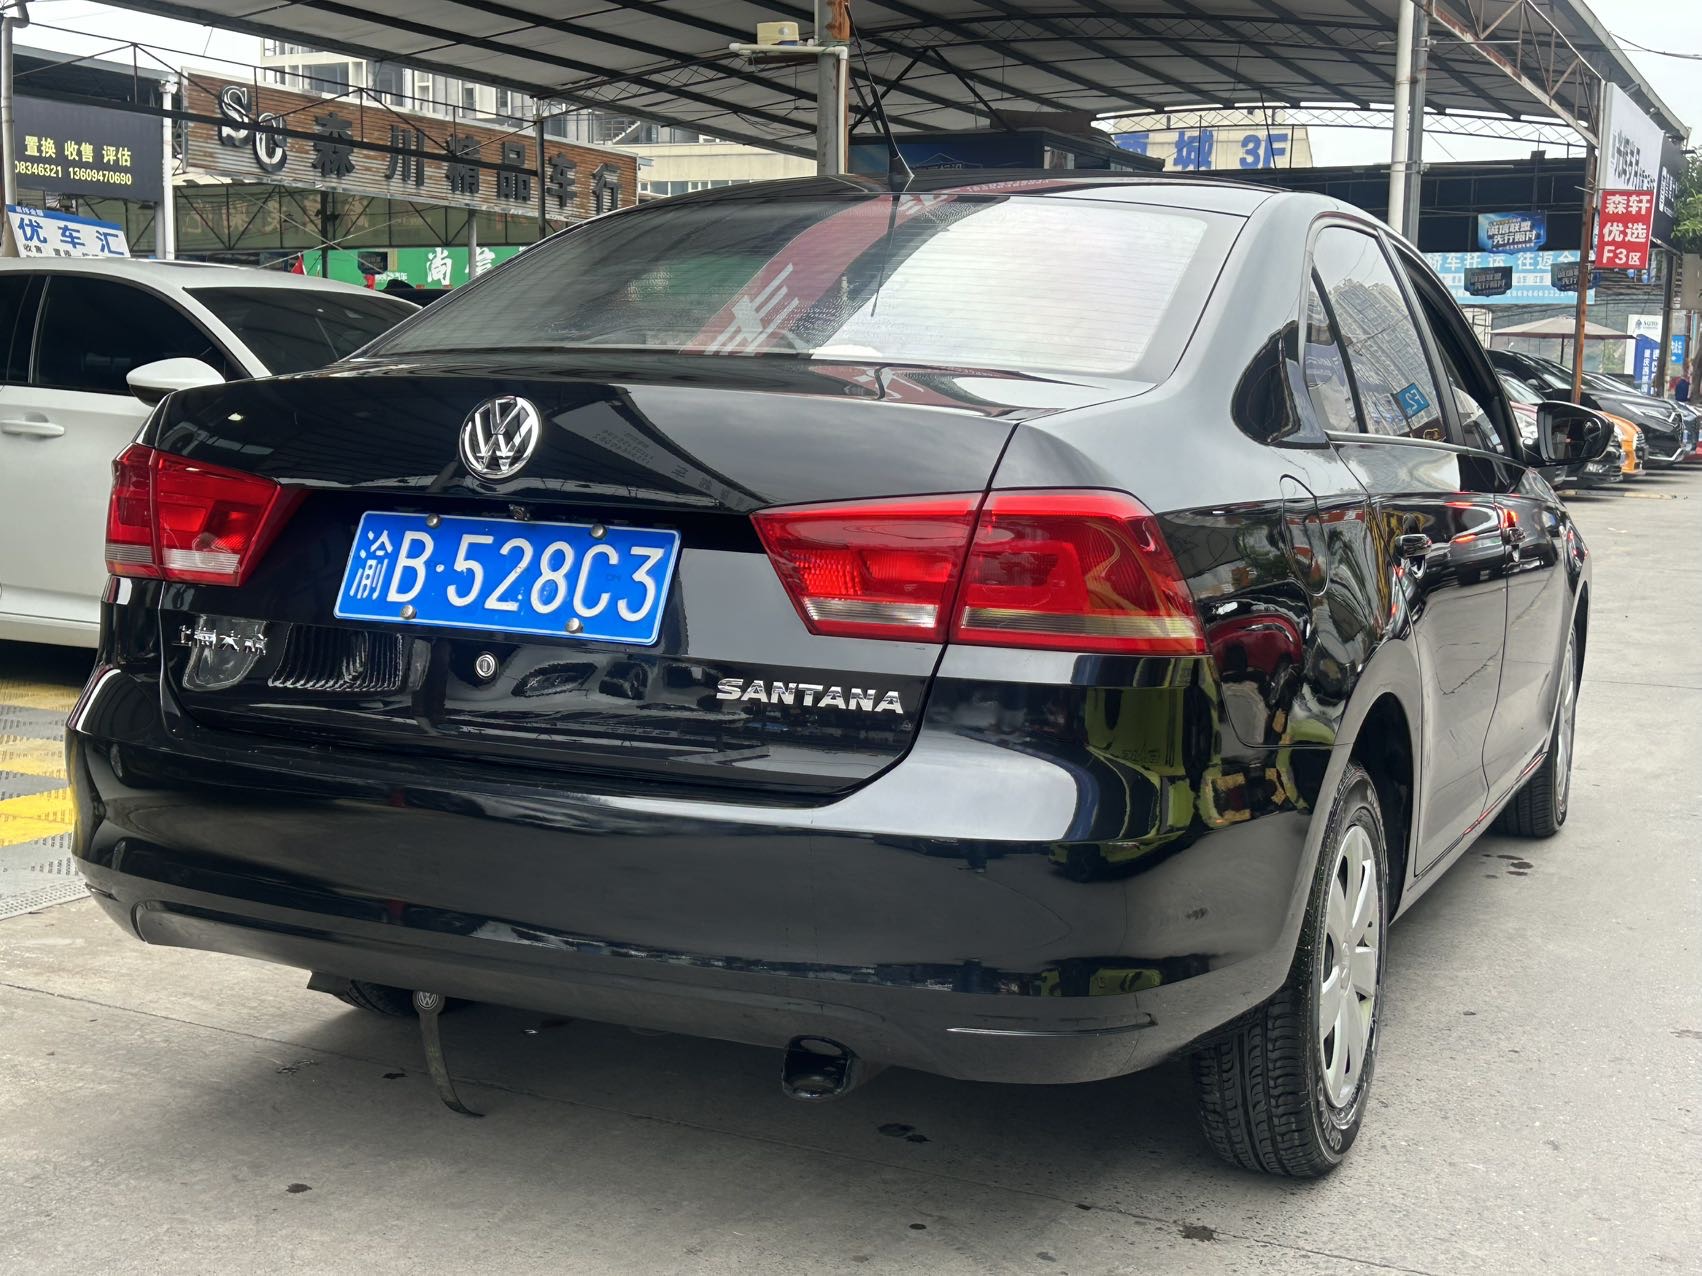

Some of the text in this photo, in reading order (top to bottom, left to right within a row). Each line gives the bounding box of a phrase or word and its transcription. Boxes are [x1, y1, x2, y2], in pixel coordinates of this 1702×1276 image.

[25, 135, 132, 167] 置换 收售 评估
[311, 112, 622, 215] 森川精品车行
[1239, 132, 1289, 170] 3F
[68, 167, 132, 186] 13609470690
[1605, 194, 1651, 215] 森轩
[17, 217, 125, 256] 优车汇
[1603, 222, 1647, 243] 优选
[1602, 246, 1642, 266] F3区
[349, 529, 665, 622] 渝B·528C3
[716, 678, 904, 714] SANTANA
